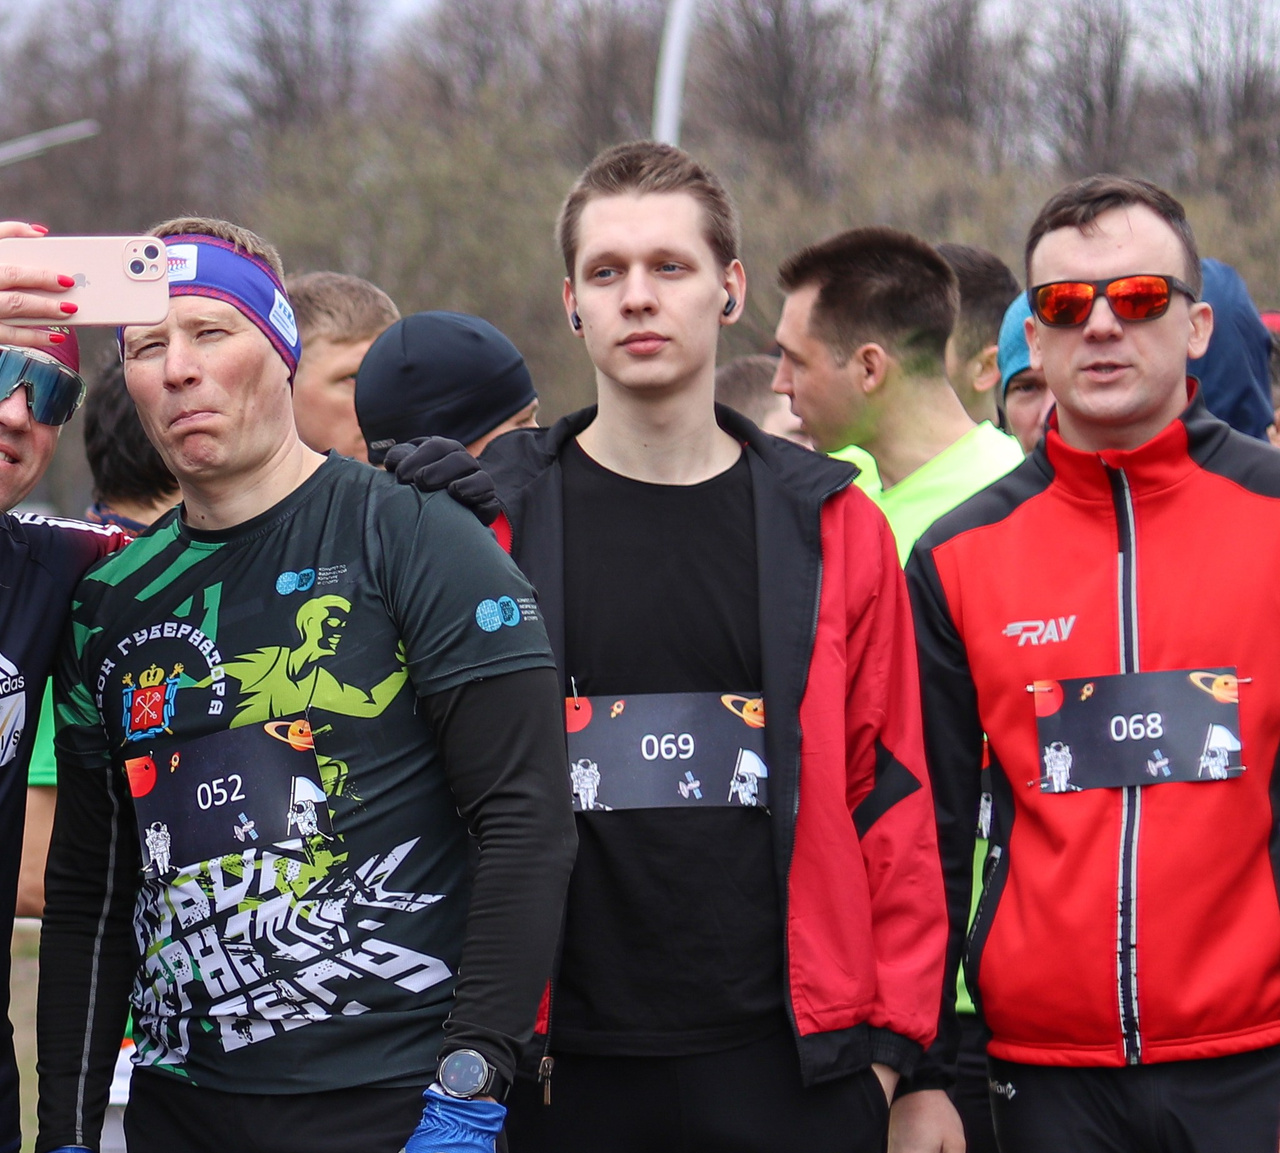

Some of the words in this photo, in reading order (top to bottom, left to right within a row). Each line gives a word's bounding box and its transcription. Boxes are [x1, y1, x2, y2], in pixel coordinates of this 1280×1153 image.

[117, 621, 226, 715] ГУБЕРНАТОРА
[1110, 712, 1164, 742] 068
[641, 733, 695, 761] 069
[196, 774, 246, 810] 052
